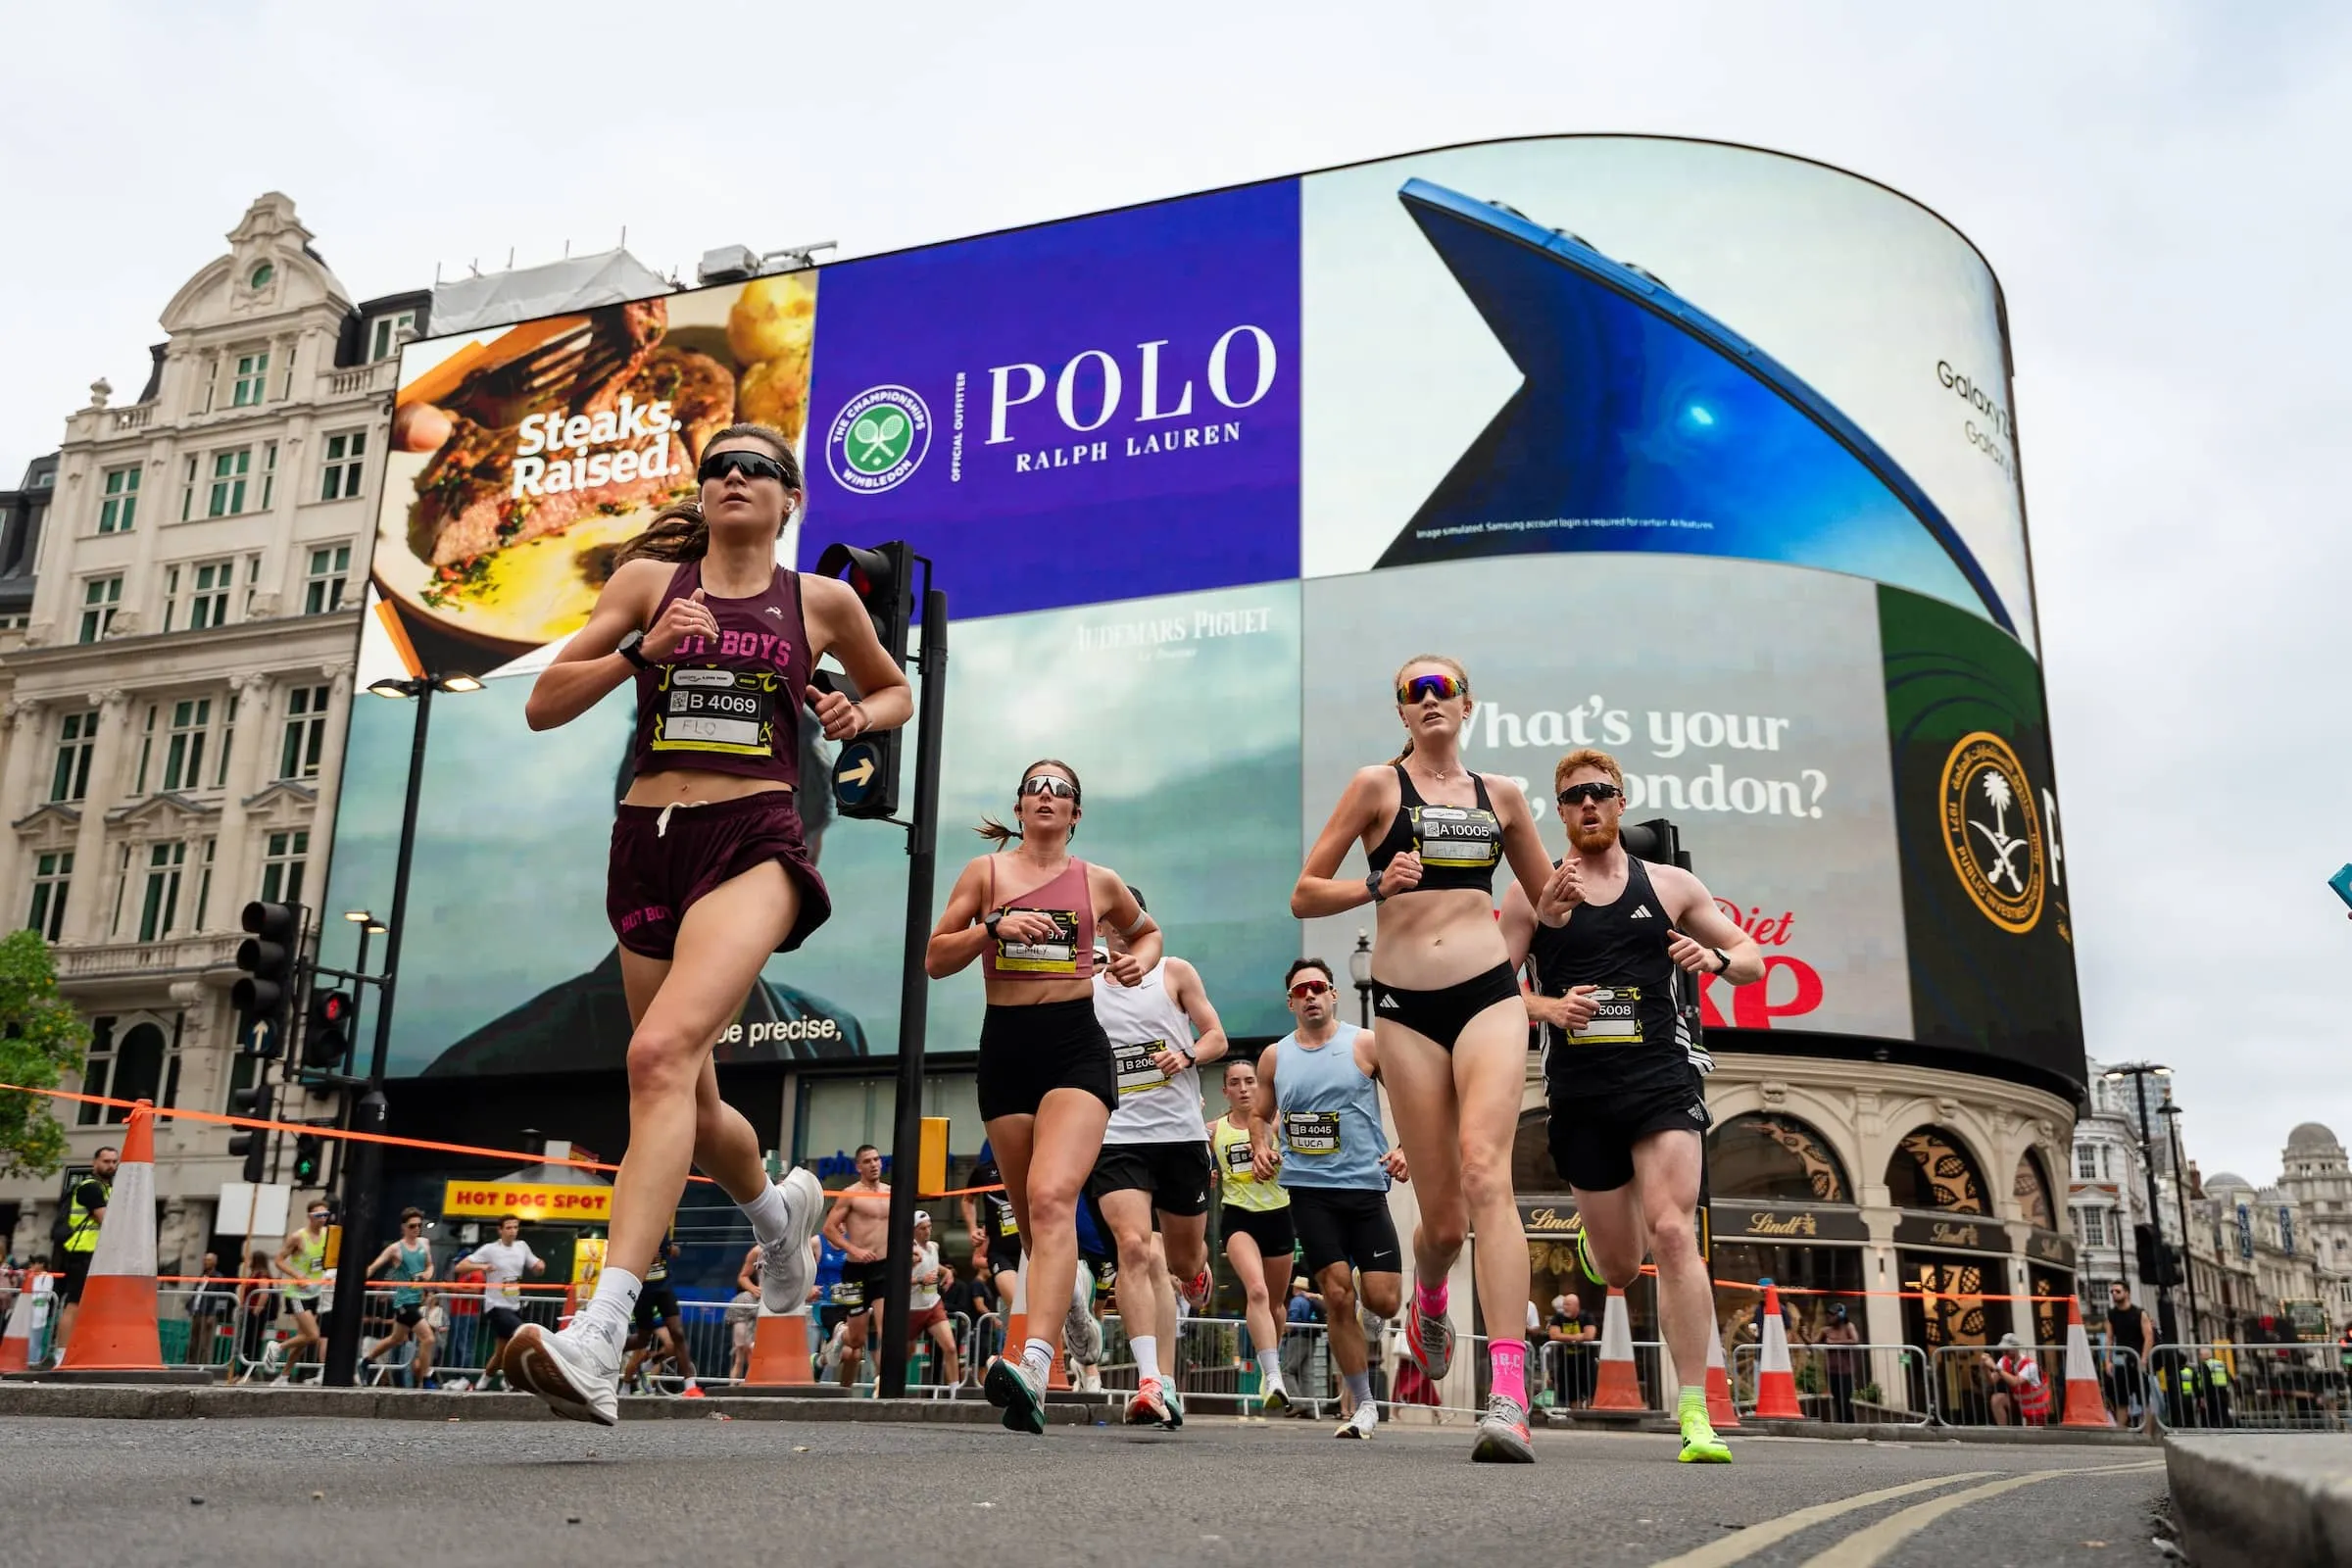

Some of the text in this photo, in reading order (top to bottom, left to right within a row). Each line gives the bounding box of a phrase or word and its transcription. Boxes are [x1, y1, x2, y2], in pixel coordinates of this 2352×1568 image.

[985, 324, 1277, 445] POLO
[516, 395, 682, 456] Steaks.
[833, 391, 926, 443] THE CHAMPIONSHIPS
[951, 371, 966, 482] OFFICIAL OUTFITTER
[1015, 421, 1241, 473] RALPH LAUREN
[511, 432, 681, 499] Raised.
[842, 459, 913, 488] WIMBLEDON
[1416, 528, 1442, 539] Image
[1486, 521, 1525, 531] Samsung
[1525, 518, 1558, 528] account
[1558, 517, 1580, 529] login
[1591, 516, 1625, 528] required
[1626, 516, 1638, 527] for
[1193, 607, 1271, 639] PIGUET
[719, 630, 792, 666] BOYS
[690, 694, 757, 713] B 4069
[682, 720, 716, 736] FLO
[1647, 710, 1789, 759] your
[1622, 764, 1827, 819] ondon?
[1440, 824, 1490, 837] A 10005
[749, 1014, 842, 1048] precise,
[1125, 1058, 1155, 1070] B 206
[1298, 1139, 1323, 1148] LUCA
[1307, 1125, 1332, 1134] 4045
[456, 1191, 607, 1209] HOT DOG SPOT
[1528, 1207, 1582, 1230] Lindt
[1747, 1212, 1801, 1235] Lindt
